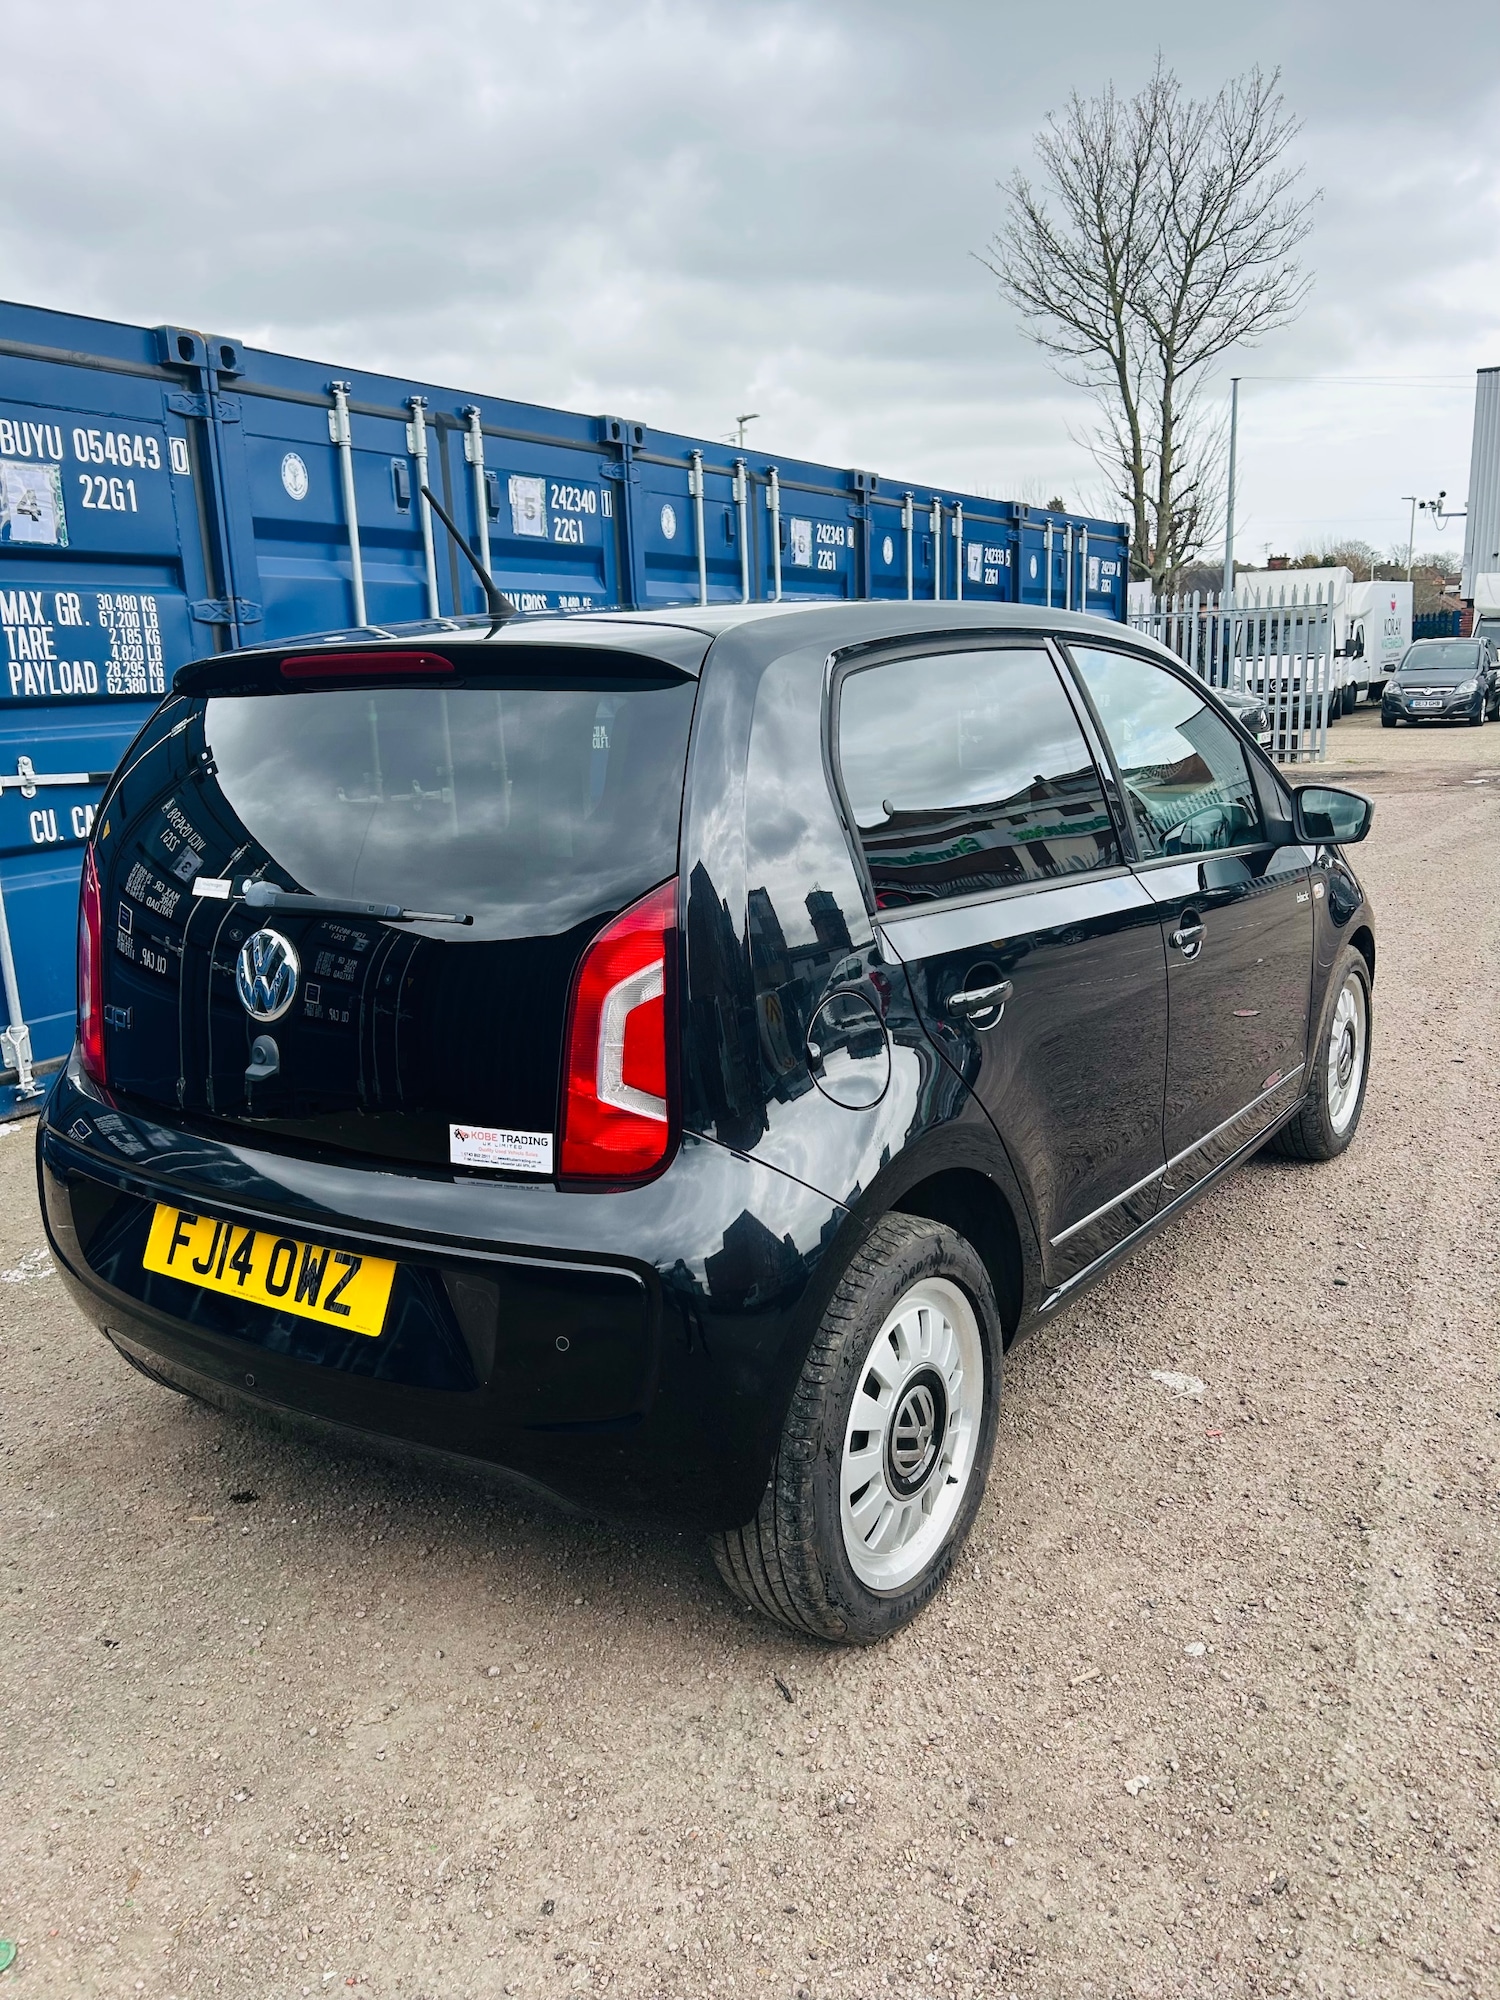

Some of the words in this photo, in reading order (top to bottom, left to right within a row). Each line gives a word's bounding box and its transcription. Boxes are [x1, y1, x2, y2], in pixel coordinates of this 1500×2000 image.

[0, 419, 63, 460] BUYU
[73, 428, 161, 470] 054643
[79, 474, 138, 512] 22G1
[551, 484, 596, 514] 242340
[524, 497, 536, 520] 5
[553, 517, 584, 544] 22G1
[816, 523, 844, 546] 242343
[818, 550, 836, 571] 22G1
[973, 557, 978, 572] 7
[140, 596, 157, 613] KG
[143, 612, 159, 628] LB
[3, 626, 58, 660] TARE
[145, 629, 160, 645] KG
[147, 645, 163, 661] LB
[8, 661, 98, 695] PAYLOAD
[148, 662, 165, 678] KG
[150, 678, 165, 694] LB
[30, 808, 65, 844] CU.
[71, 804, 99, 838] CA
[470, 1131, 498, 1141] KOBE
[500, 1134, 548, 1146] TRADING
[167, 1212, 256, 1287] FJ14
[265, 1237, 363, 1317] OWZ
